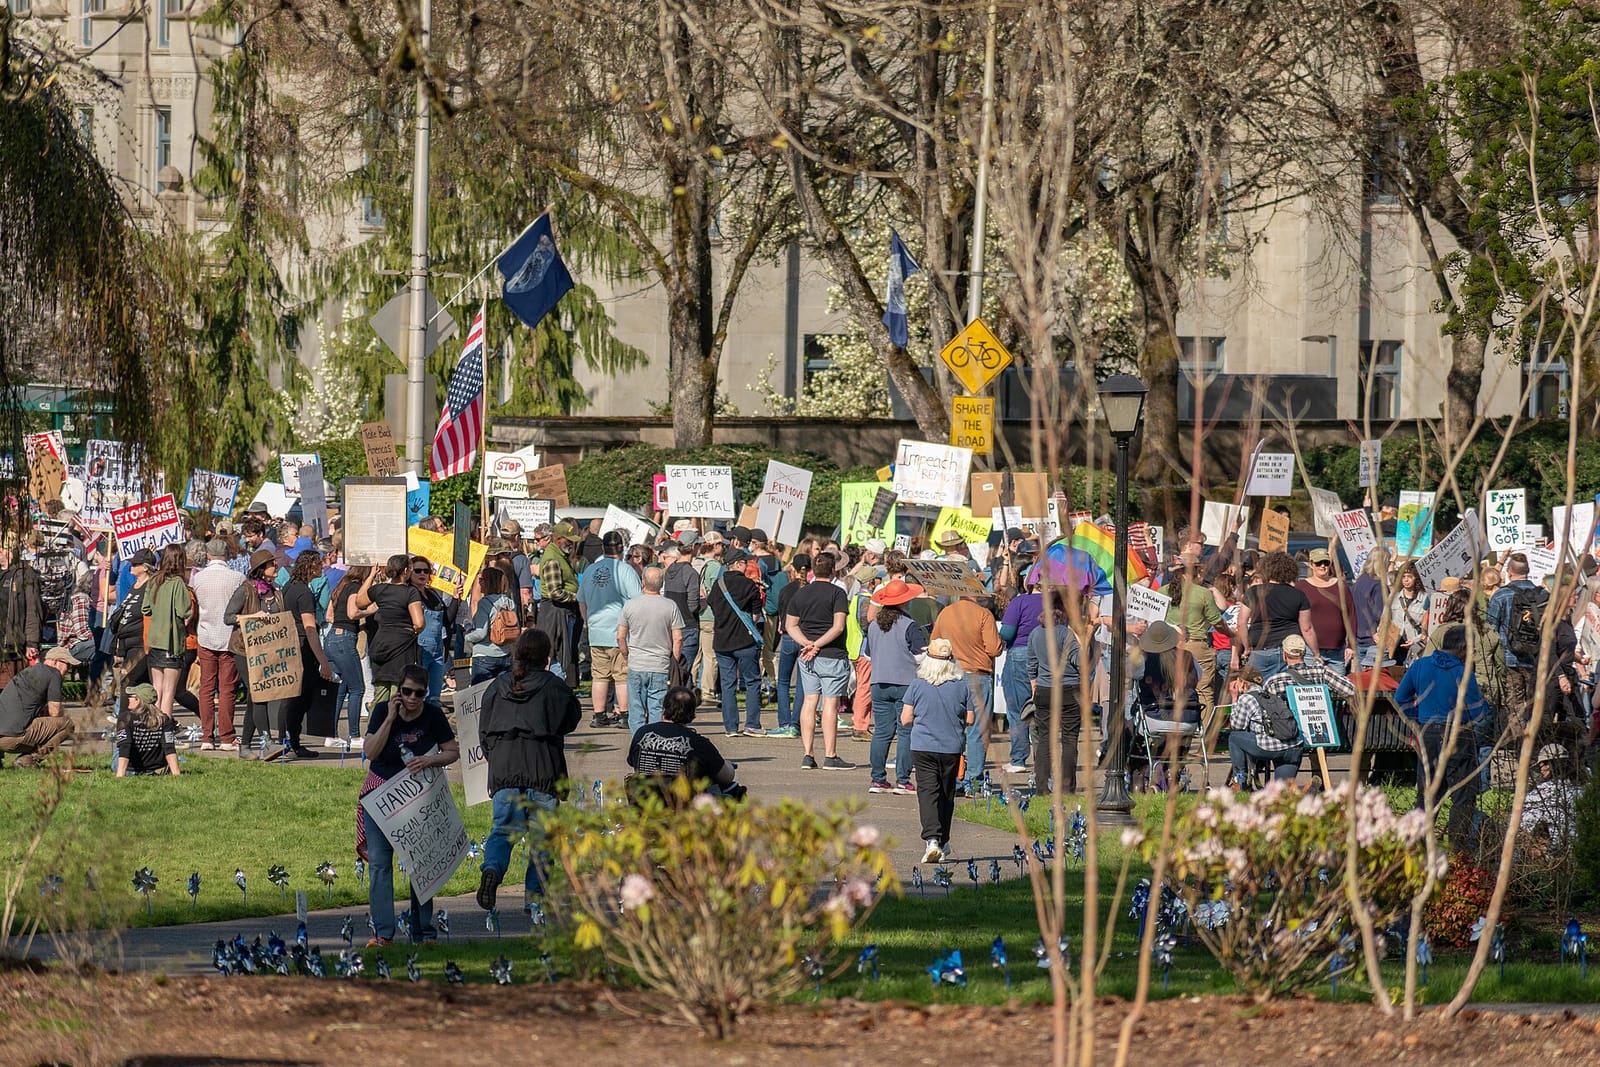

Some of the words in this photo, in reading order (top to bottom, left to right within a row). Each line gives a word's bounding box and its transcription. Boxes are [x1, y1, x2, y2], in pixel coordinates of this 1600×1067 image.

[956, 404, 990, 416] SHARE
[962, 420, 982, 431] THE
[957, 436, 986, 448] ROAD
[898, 444, 958, 473] Impeach
[496, 462, 522, 473] STOP
[670, 468, 688, 478] GET
[692, 468, 707, 477] THE
[710, 468, 730, 477] HORSE
[686, 482, 704, 490] OUT
[772, 482, 806, 501] REMOVE
[895, 483, 946, 502] Prosecute
[692, 492, 710, 500] THE
[764, 492, 794, 510] TRUMP
[114, 507, 148, 525] STOP
[151, 501, 174, 514] THE
[676, 501, 731, 513] HOSPITAL
[1496, 502, 1515, 515] 47
[116, 511, 177, 535] NONSENSE
[1334, 510, 1369, 529] HANDS
[1490, 514, 1520, 526] DUMP
[1344, 528, 1363, 542] OFF
[1500, 526, 1518, 534] THE
[1494, 534, 1520, 545] GOP
[911, 561, 964, 574] HANDS
[1418, 552, 1440, 570] HERE
[1420, 560, 1442, 579] VETS
[249, 652, 268, 668] EAT
[275, 646, 298, 660] THE
[263, 661, 288, 679] RICH
[252, 672, 299, 692] INSTEAD!
[460, 701, 474, 717] THE
[376, 776, 422, 818] HANDS
[390, 816, 420, 842] SOCIAL
[419, 786, 450, 822] SECURITY
[408, 818, 452, 861] MEDICARE
